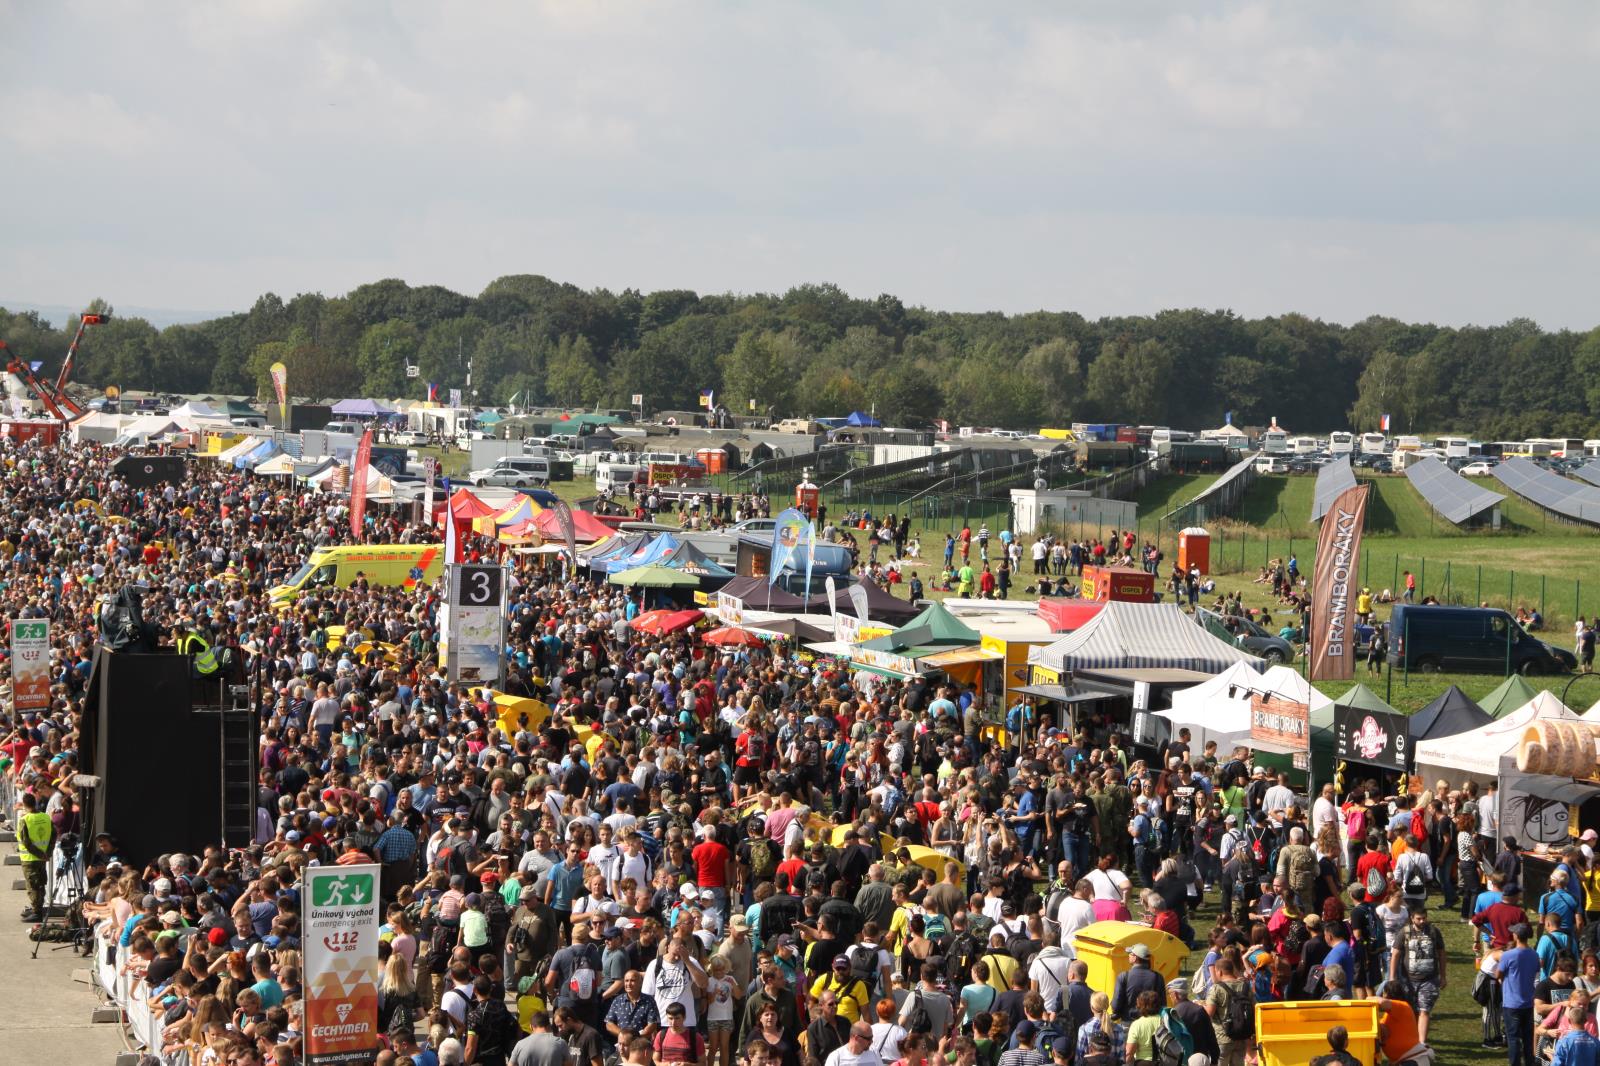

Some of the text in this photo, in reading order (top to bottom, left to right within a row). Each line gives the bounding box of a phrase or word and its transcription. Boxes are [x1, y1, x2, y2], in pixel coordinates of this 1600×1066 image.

[470, 571, 491, 603] 3
[1328, 508, 1355, 657] BRAMBORÁKY
[1253, 710, 1305, 735] BRAMBORÁKY
[346, 907, 374, 918] východ
[313, 917, 373, 929] Emergency exit
[331, 931, 359, 945] 112
